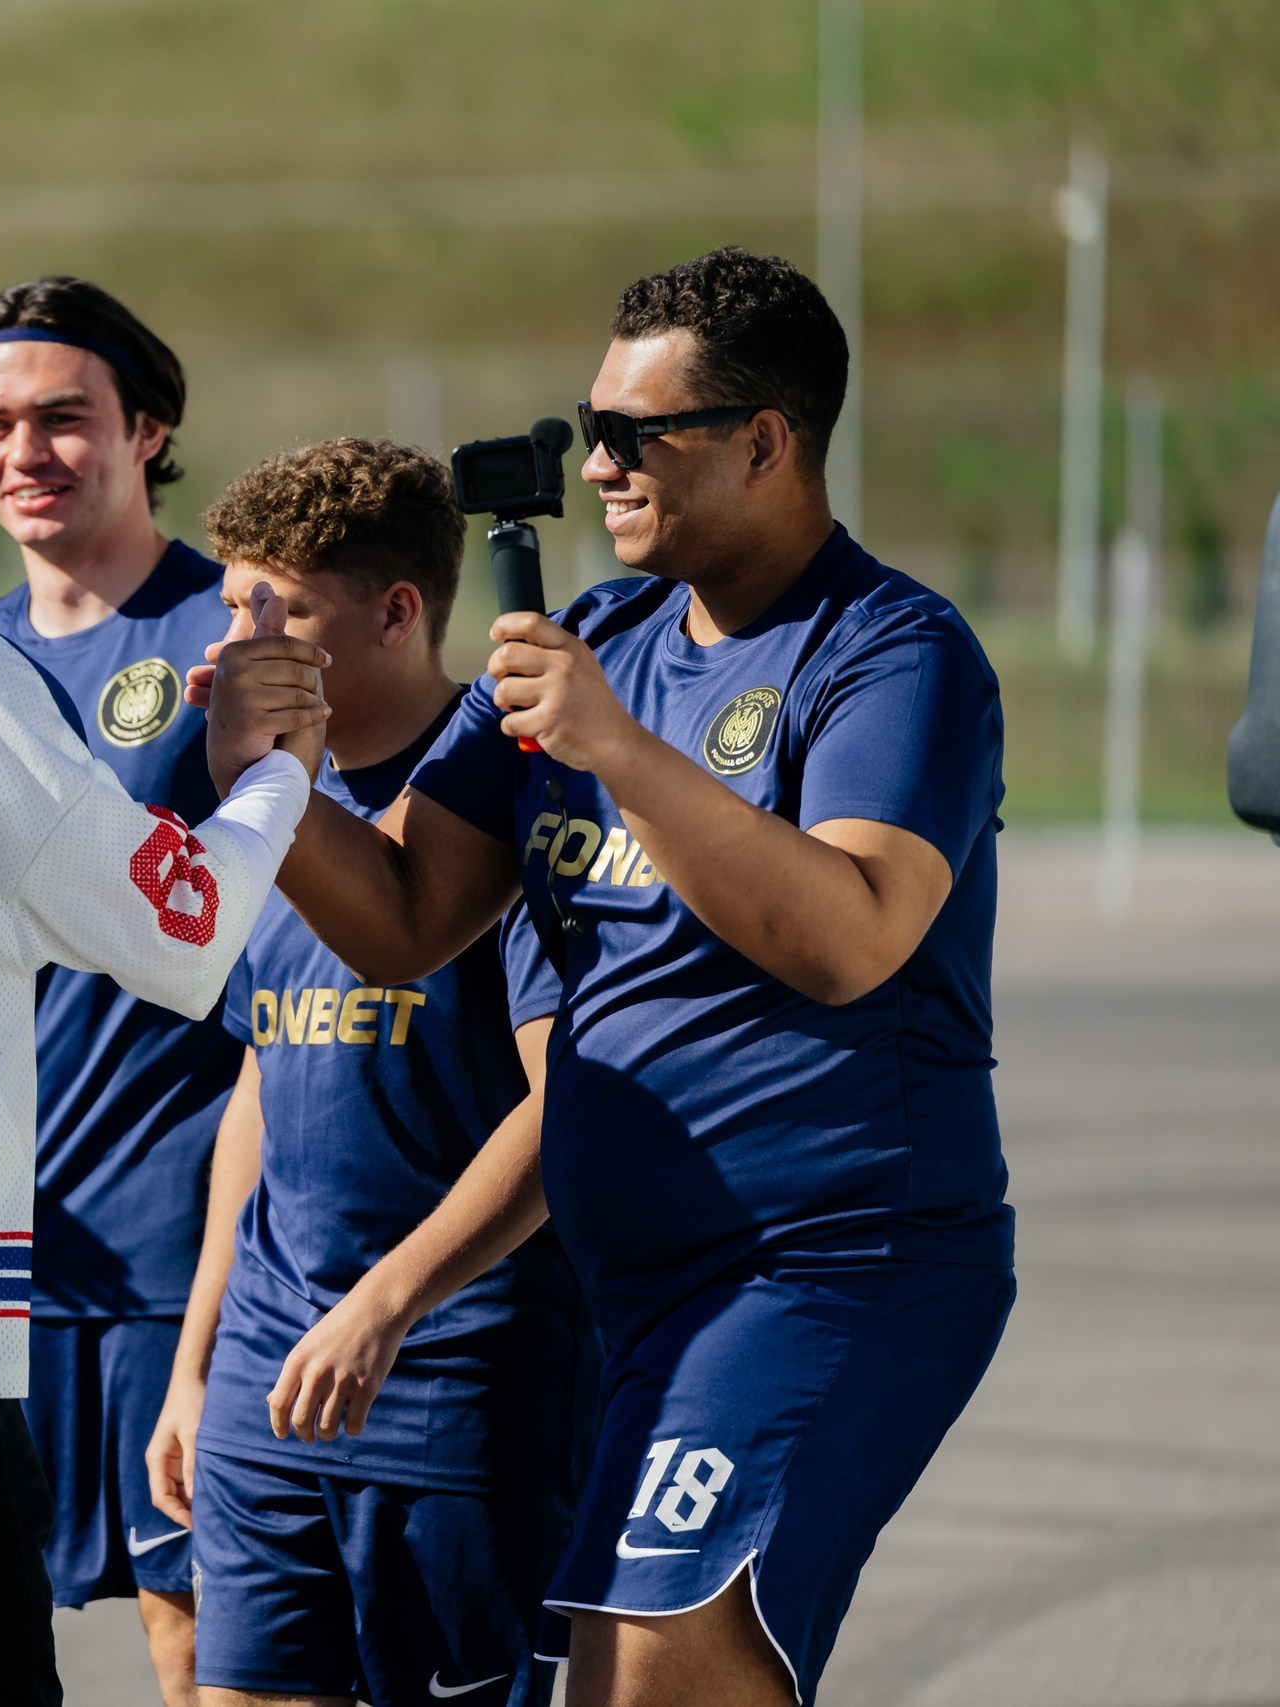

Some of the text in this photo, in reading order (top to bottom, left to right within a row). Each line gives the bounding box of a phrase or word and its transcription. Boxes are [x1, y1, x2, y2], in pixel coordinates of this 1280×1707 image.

[744, 691, 775, 709] DROTS
[523, 811, 667, 887] FONB
[251, 987, 426, 1047] ONBET
[627, 1438, 735, 1533] 18
